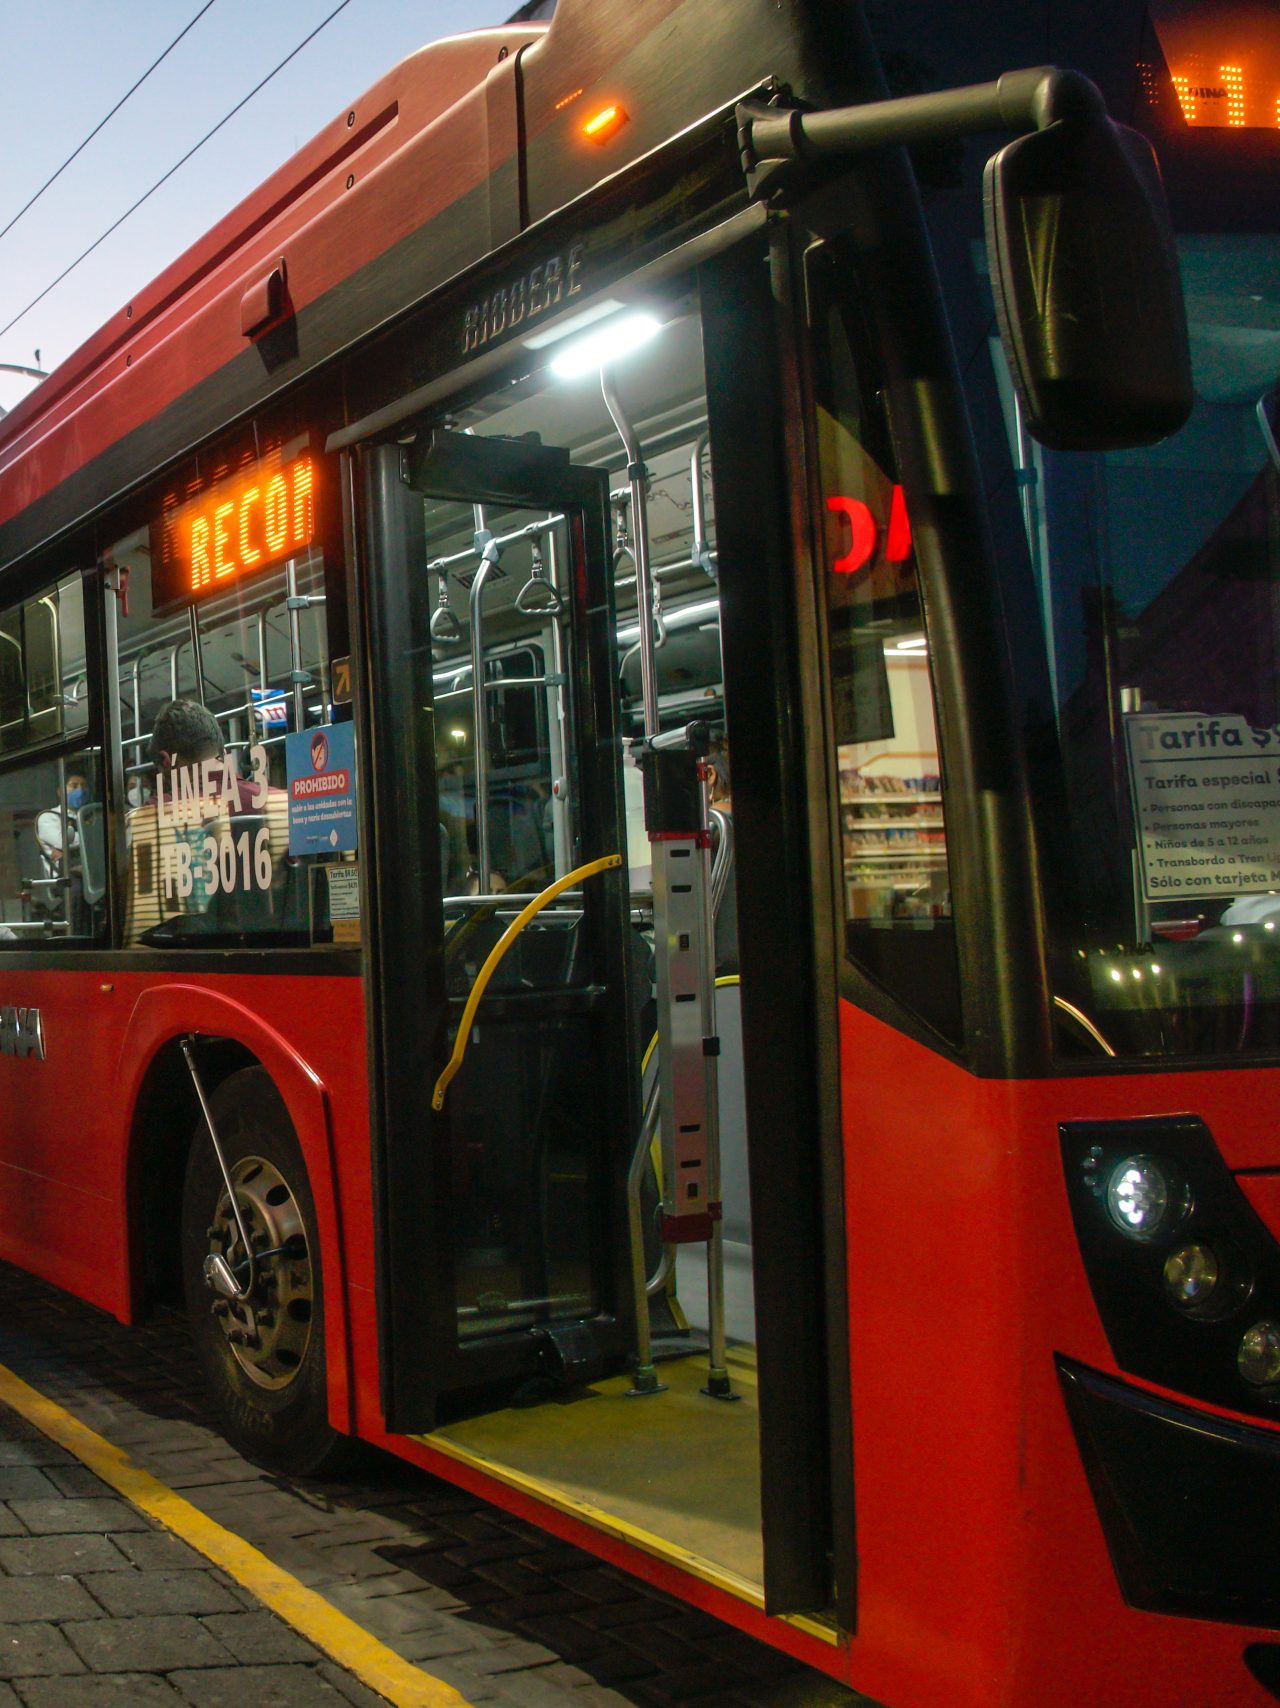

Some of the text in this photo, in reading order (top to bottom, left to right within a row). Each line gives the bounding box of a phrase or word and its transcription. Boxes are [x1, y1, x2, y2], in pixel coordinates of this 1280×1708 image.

[1139, 721, 1242, 750] Tarifa
[156, 744, 268, 828] LÍNEA 3
[294, 773, 346, 796] PROHIBIDO
[1144, 774, 1198, 790] Tarifa
[1202, 771, 1271, 790] especial
[1150, 802, 1204, 814] Personas
[1207, 801, 1228, 811] con
[1152, 818, 1260, 832] Personas mayores
[1155, 835, 1269, 850] Niños de 5 a 12 años
[160, 827, 273, 899] TB-3016
[1157, 856, 1225, 868] Transbordo
[1228, 856, 1236, 864] a
[1237, 854, 1264, 864] Tren
[1150, 873, 1182, 888] Sólo
[1185, 876, 1211, 886] con
[1215, 871, 1267, 887] tarjeta
